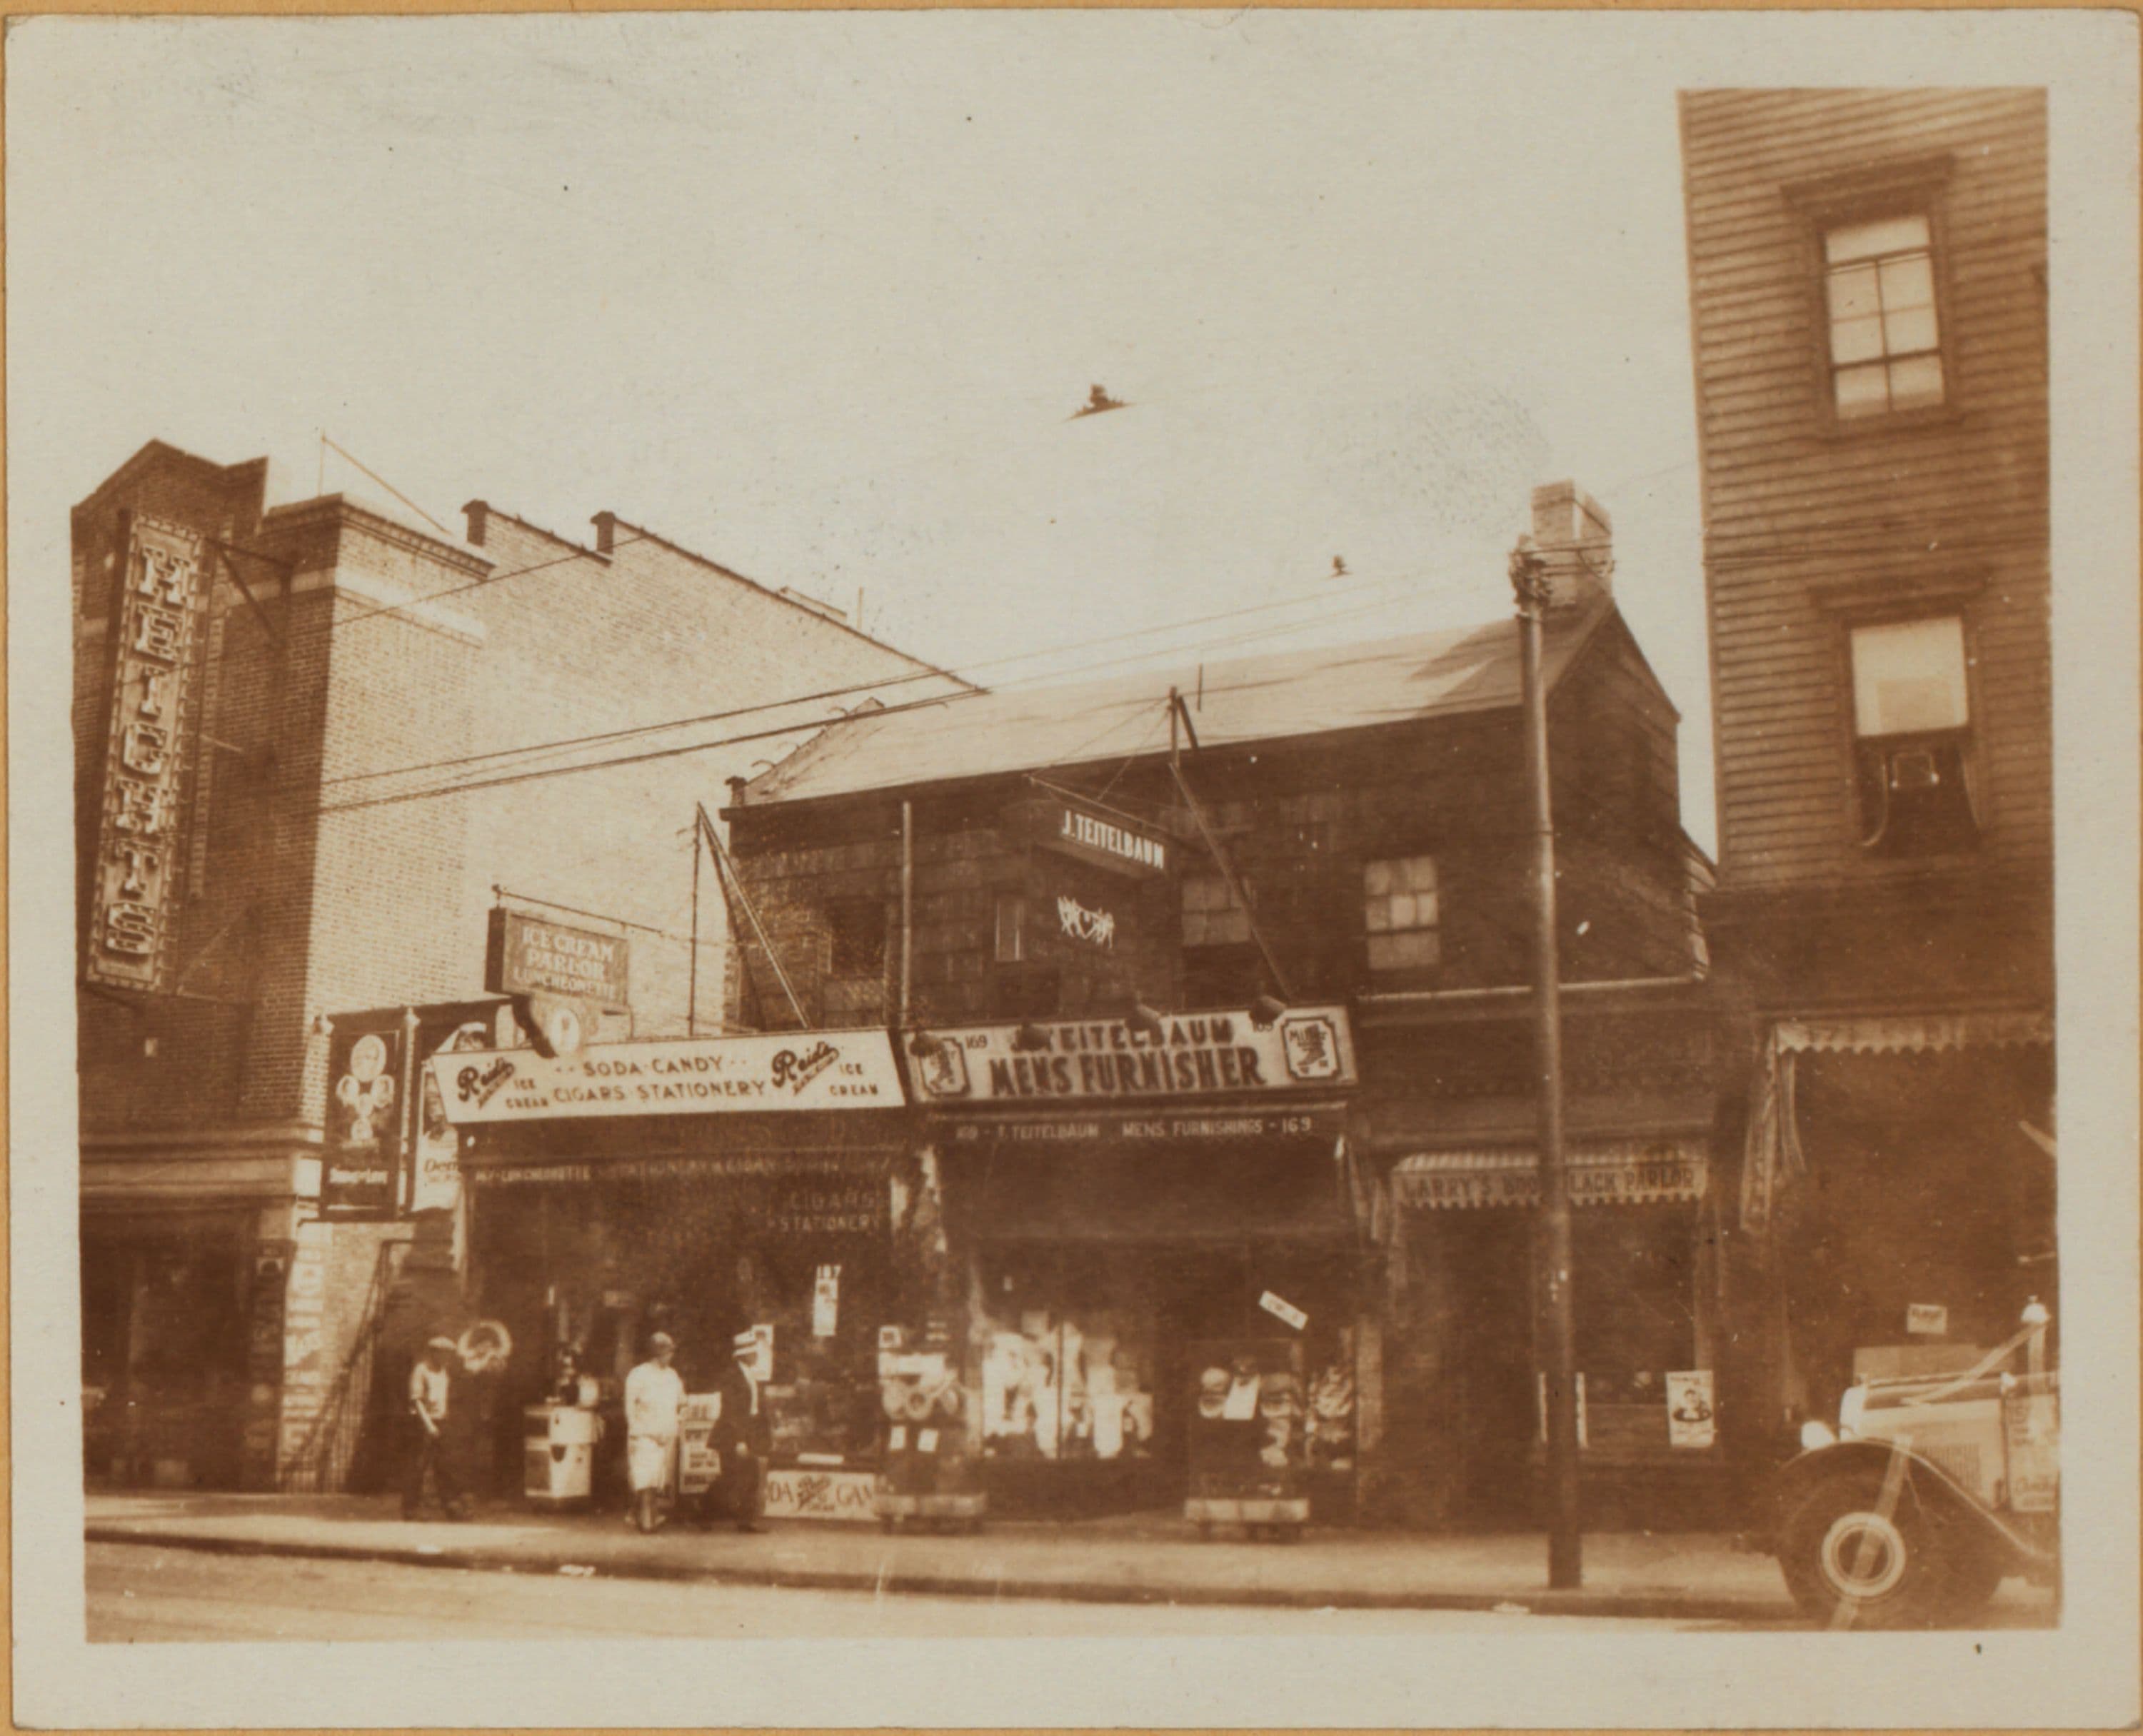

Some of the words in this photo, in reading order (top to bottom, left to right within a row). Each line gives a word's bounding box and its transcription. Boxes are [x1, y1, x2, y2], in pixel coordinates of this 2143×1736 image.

[106, 546, 190, 955] HEIGHTS
[522, 925, 551, 949] ICE
[554, 935, 614, 962] CREAM
[526, 948, 606, 981] PARLOR
[513, 965, 617, 1000] LUNCHEONETTE
[965, 1035, 989, 1050] 169
[583, 1060, 643, 1078] SODA
[651, 1055, 723, 1075] CANDY
[839, 1062, 865, 1075] ICE
[988, 1055, 1072, 1096] MENS
[1078, 1045, 1266, 1093] FURNISHER
[513, 1077, 536, 1090] ICE
[553, 1084, 626, 1103] CIGARS
[636, 1079, 766, 1100] STATIONERY
[1122, 1121, 1166, 1138] MENS
[1172, 1118, 1264, 1138] FURNISHINGS
[1282, 1116, 1313, 1134] 169
[1569, 1170, 1617, 1193] LACK
